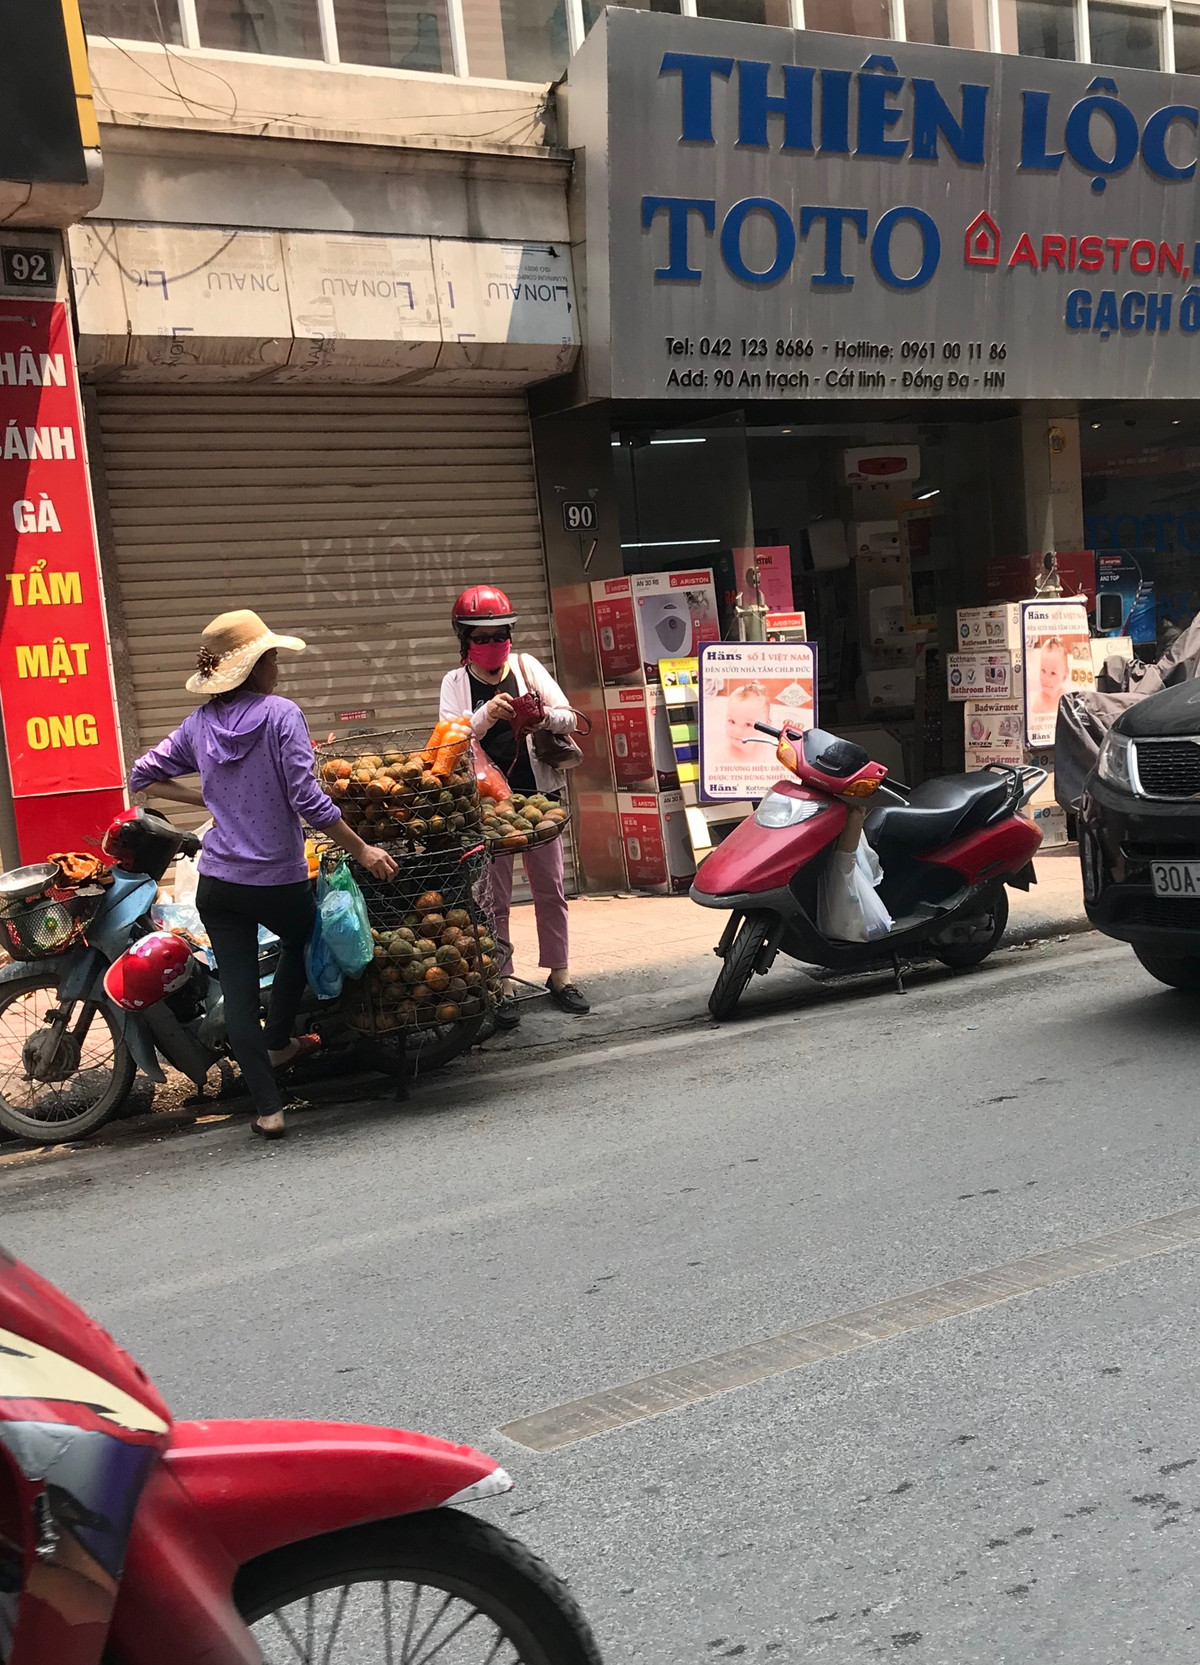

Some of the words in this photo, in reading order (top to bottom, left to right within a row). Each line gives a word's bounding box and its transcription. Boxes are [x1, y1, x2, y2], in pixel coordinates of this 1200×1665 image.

[657, 52, 990, 165] THIÊN
[1016, 75, 1200, 194] LỘC
[641, 195, 942, 290] TOTO
[12, 254, 48, 281] 92
[321, 278, 415, 310] LIONALU
[487, 282, 572, 313] LIONALU
[1066, 288, 1173, 338] GẠCH
[665, 337, 695, 358] Tel:
[699, 337, 732, 358] 042
[740, 338, 769, 358] 123
[775, 338, 814, 358] 8686
[834, 339, 895, 359] Hotline:
[900, 341, 936, 360] 0961
[942, 341, 962, 360] 00
[968, 342, 983, 360] 11
[989, 342, 1008, 361] 86
[666, 368, 709, 388] Add:
[713, 369, 735, 388] 90
[738, 370, 762, 389] An
[765, 369, 810, 393] trạch
[825, 366, 856, 388] Cát
[858, 370, 886, 388] linh
[902, 367, 944, 392] Đống
[947, 370, 970, 388] Đa
[984, 371, 1006, 389] HN
[0, 419, 76, 461] ÁNH
[13, 491, 62, 534] GÀ
[568, 506, 593, 527] 90
[6, 558, 84, 607] TẨM
[680, 576, 709, 585] ARISTON
[772, 619, 801, 627] ARISTON
[1027, 611, 1049, 620] Häns
[15, 636, 91, 685] MẬT
[706, 651, 742, 661] Häns
[747, 652, 759, 661] SỐ
[761, 651, 766, 661] 1
[768, 653, 788, 662] VIỆT
[790, 653, 810, 661] NAM
[951, 686, 985, 694] Bathroom
[985, 685, 1009, 693] Heater
[974, 703, 1019, 712] Badwärmer
[25, 713, 99, 751] ONG
[1031, 733, 1051, 741] Häns
[975, 755, 1021, 764] Badwärmer
[709, 783, 738, 792] Häns
[637, 799, 657, 808] ARISTON
